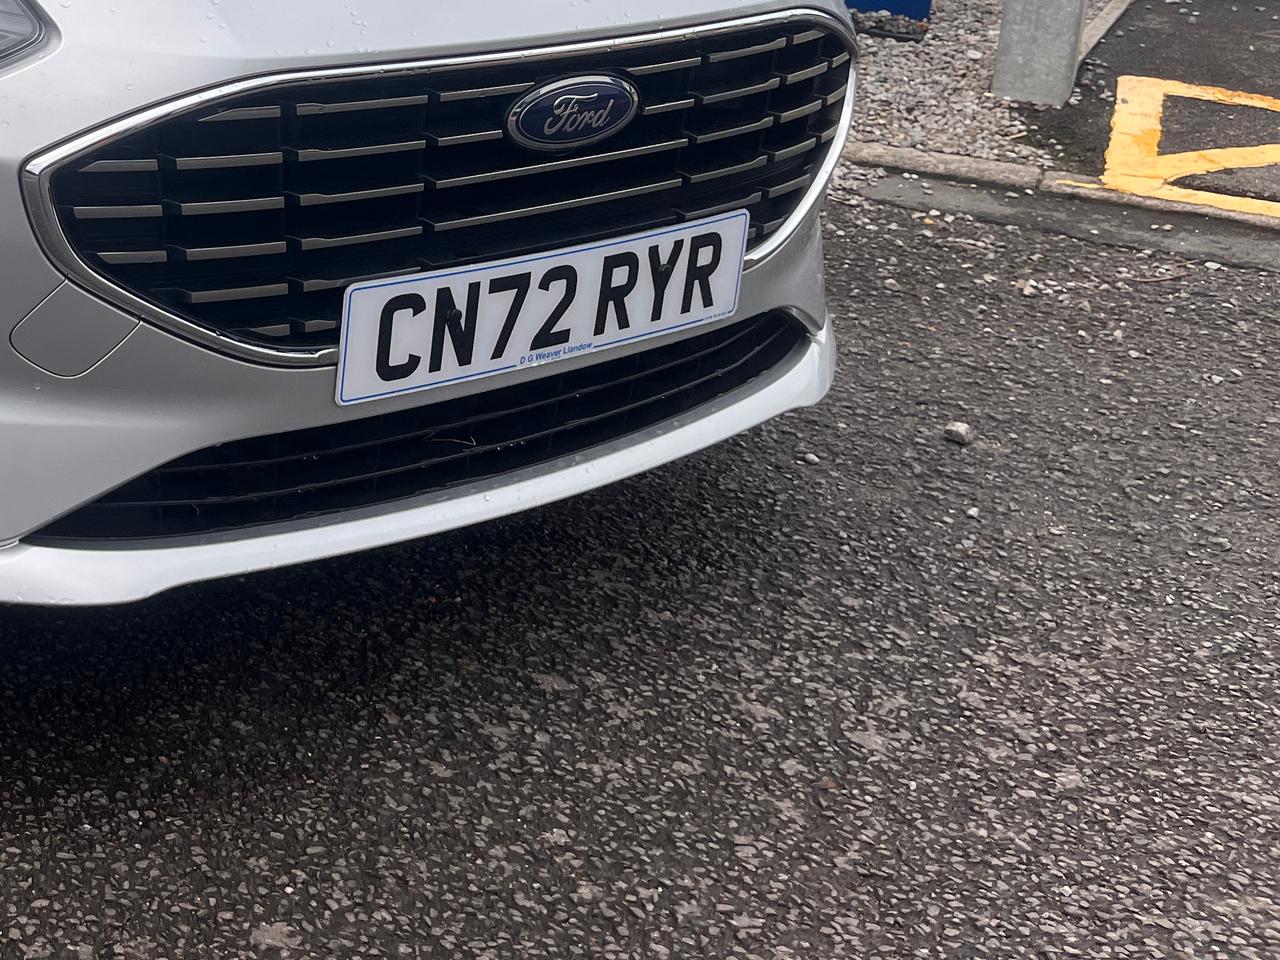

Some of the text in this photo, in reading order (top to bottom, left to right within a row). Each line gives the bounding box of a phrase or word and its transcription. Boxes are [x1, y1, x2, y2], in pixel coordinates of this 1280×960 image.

[543, 92, 615, 135] Ford
[375, 231, 723, 382] CN72 RYR
[519, 356, 526, 365] D
[527, 354, 534, 363] G
[535, 349, 562, 361] Weaver
